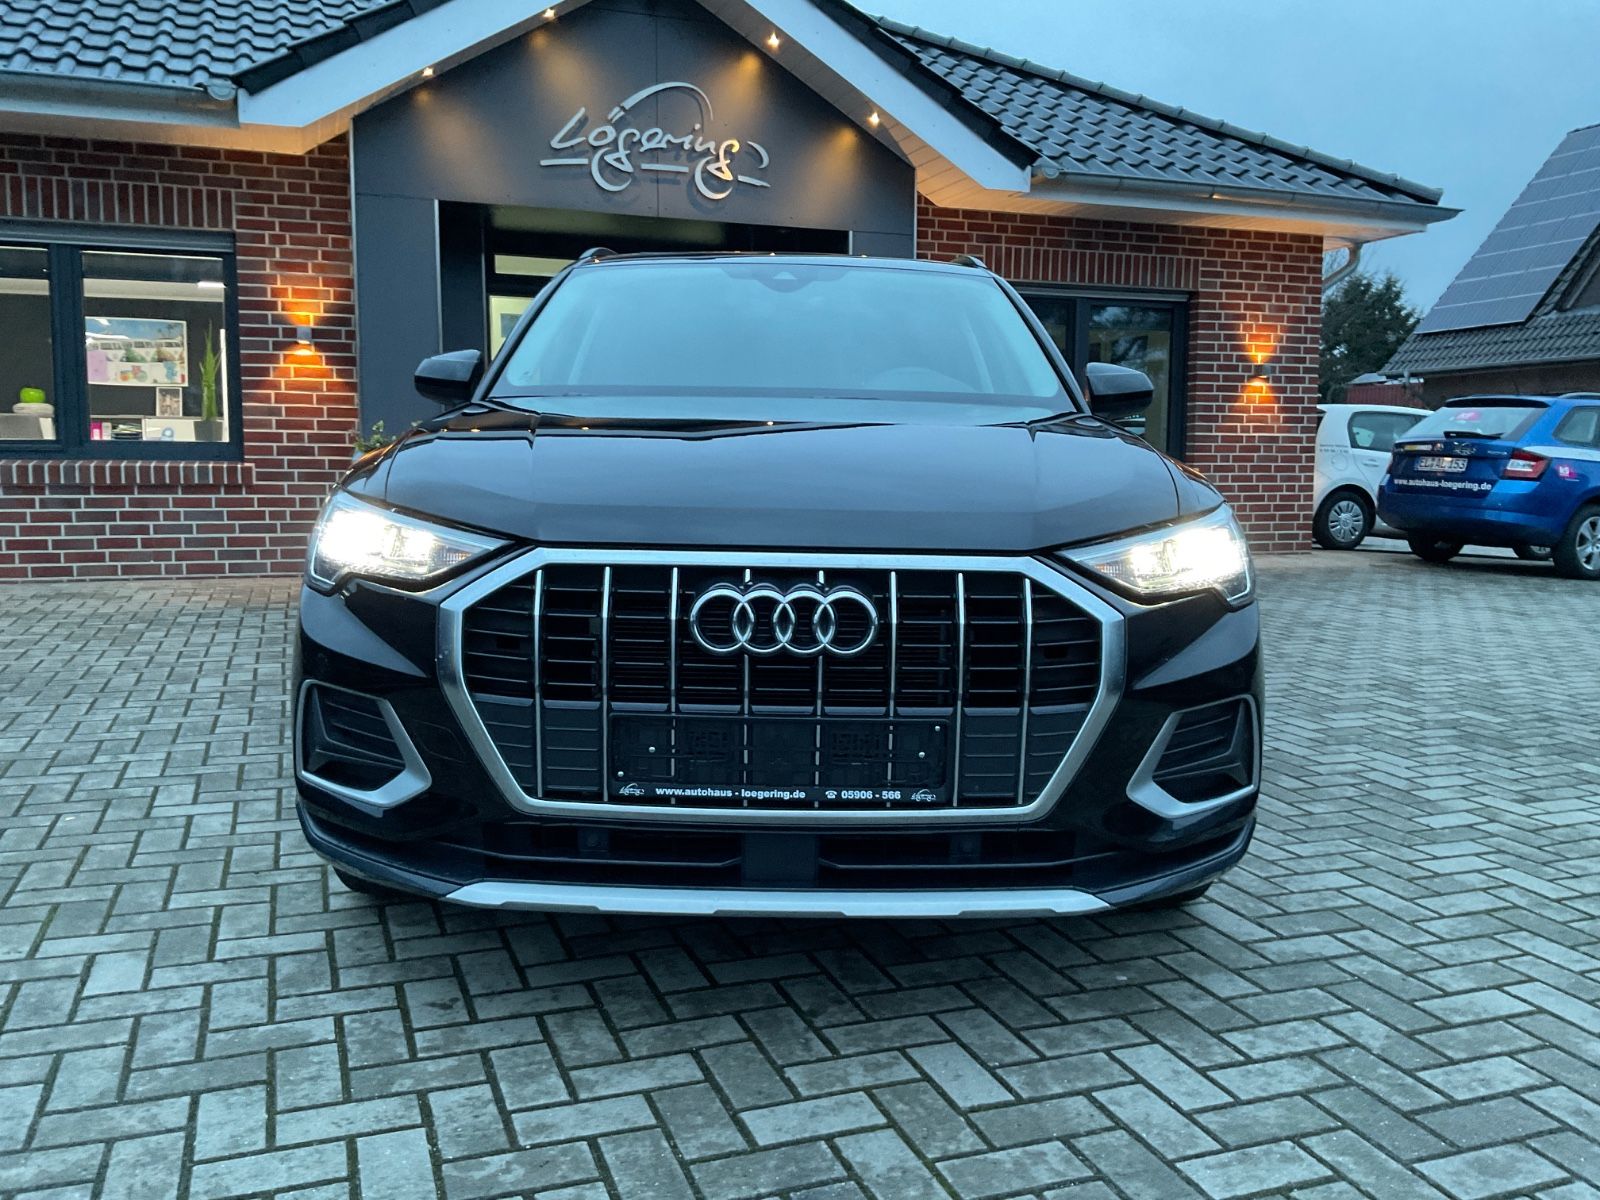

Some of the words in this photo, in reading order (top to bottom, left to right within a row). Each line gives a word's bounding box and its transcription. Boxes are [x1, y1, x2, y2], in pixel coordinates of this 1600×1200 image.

[655, 787, 732, 797] www.autohaus
[741, 788, 806, 799] loegering.de
[841, 790, 873, 799] 05906
[881, 790, 901, 799] 566
